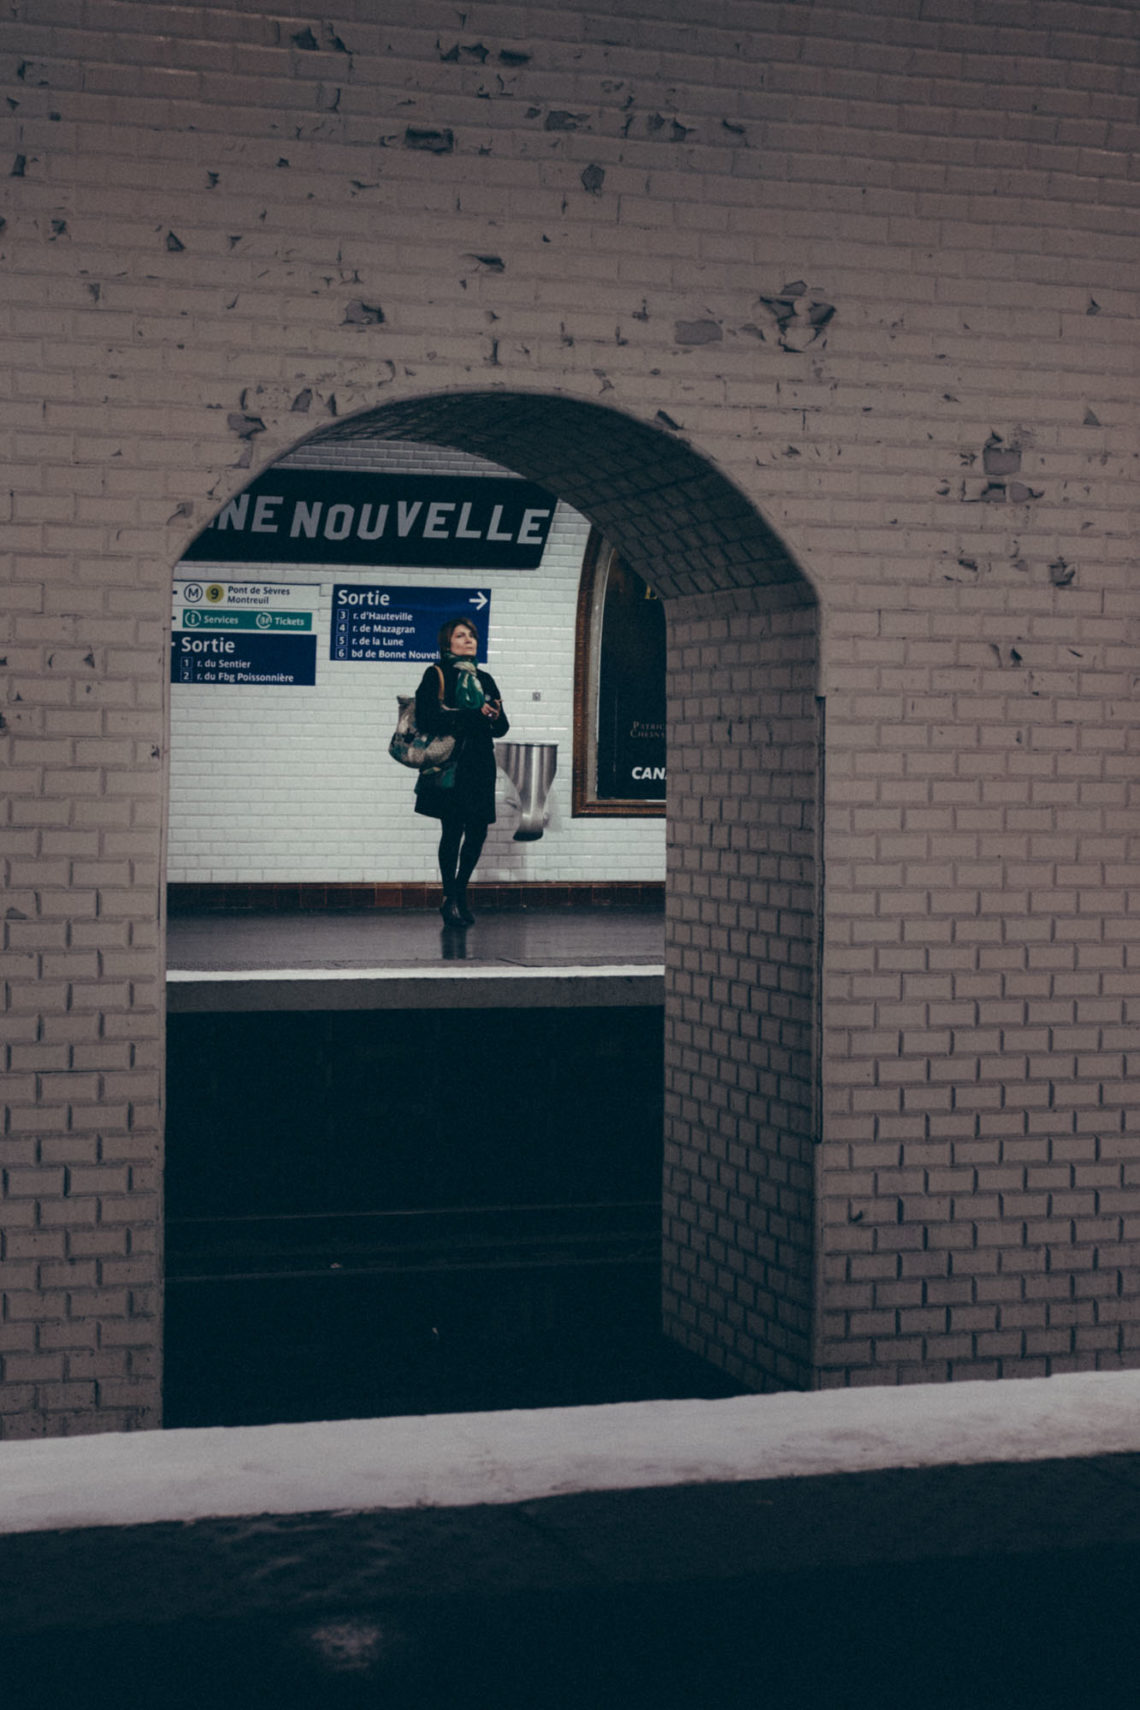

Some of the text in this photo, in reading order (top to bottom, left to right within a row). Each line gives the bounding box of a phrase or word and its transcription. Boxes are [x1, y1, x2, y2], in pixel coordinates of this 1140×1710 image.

[206, 494, 550, 544] NE NOUVELLE
[210, 588, 219, 600] 9
[227, 586, 290, 596] Pont de Sèvres
[227, 596, 269, 604] Montreuil
[337, 589, 390, 606] Sortie
[204, 616, 239, 625] Services
[275, 617, 304, 626] Tickets
[339, 612, 346, 620] 3
[360, 612, 413, 621] d'Hauteville
[339, 624, 345, 632] 4
[359, 625, 371, 633] de
[373, 625, 415, 635] Mazagran
[181, 637, 235, 653] Sortie
[359, 637, 370, 646] de
[372, 638, 380, 646] la
[383, 638, 404, 646] Lune
[338, 650, 344, 658] 6
[351, 650, 363, 658] bd
[365, 650, 376, 658] de
[378, 650, 406, 659] Bonne
[197, 660, 203, 668] r.
[204, 659, 216, 668] du
[218, 660, 251, 669] Sentier
[183, 672, 189, 680] 2
[204, 672, 216, 681] du
[218, 672, 235, 683] Fbg
[237, 673, 294, 683] Poissonnière
[631, 766, 667, 780] CAN
